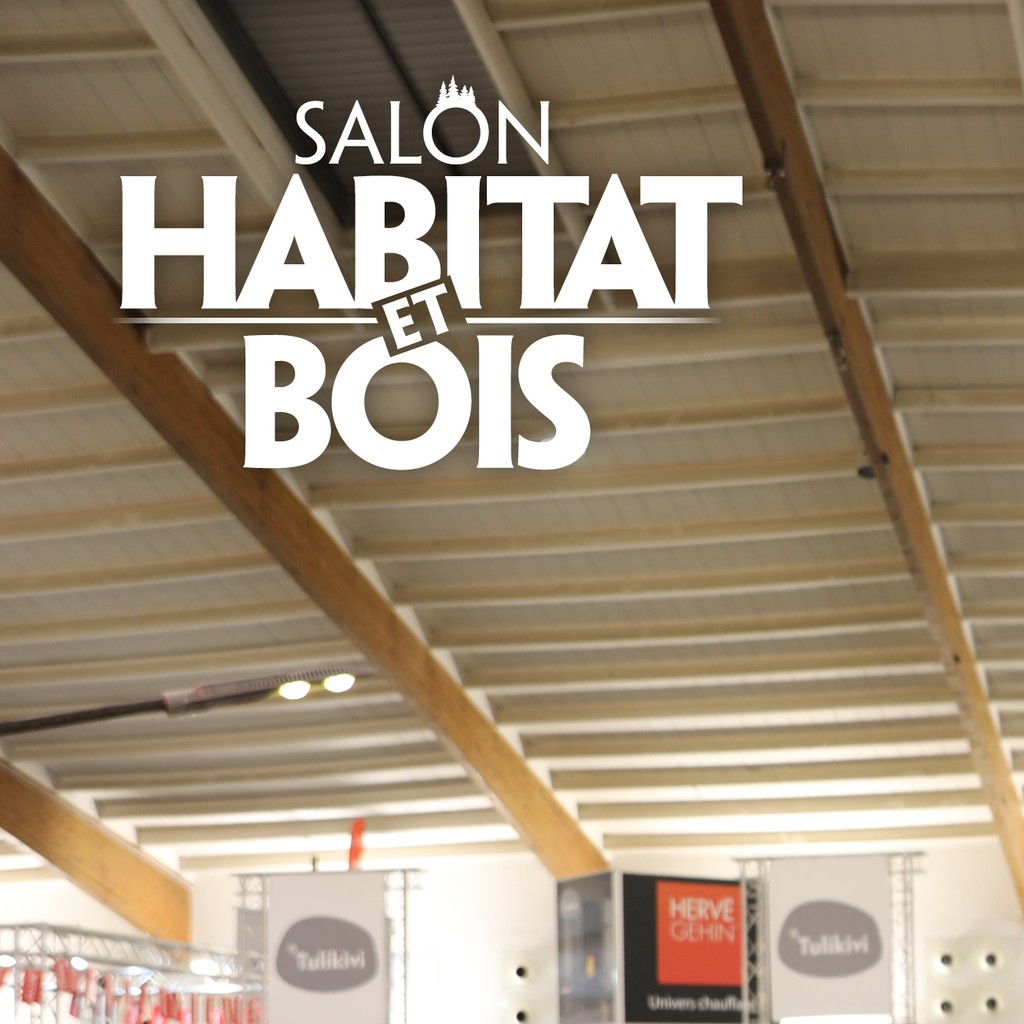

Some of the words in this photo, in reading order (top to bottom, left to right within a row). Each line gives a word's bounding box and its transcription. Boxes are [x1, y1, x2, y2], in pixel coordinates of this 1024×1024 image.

[670, 921, 735, 942] GEHIN
[799, 933, 869, 956] Tulikivi
[296, 948, 366, 971] Tulikivi
[647, 993, 697, 1012] Univers
[698, 994, 747, 1012] chauffa
